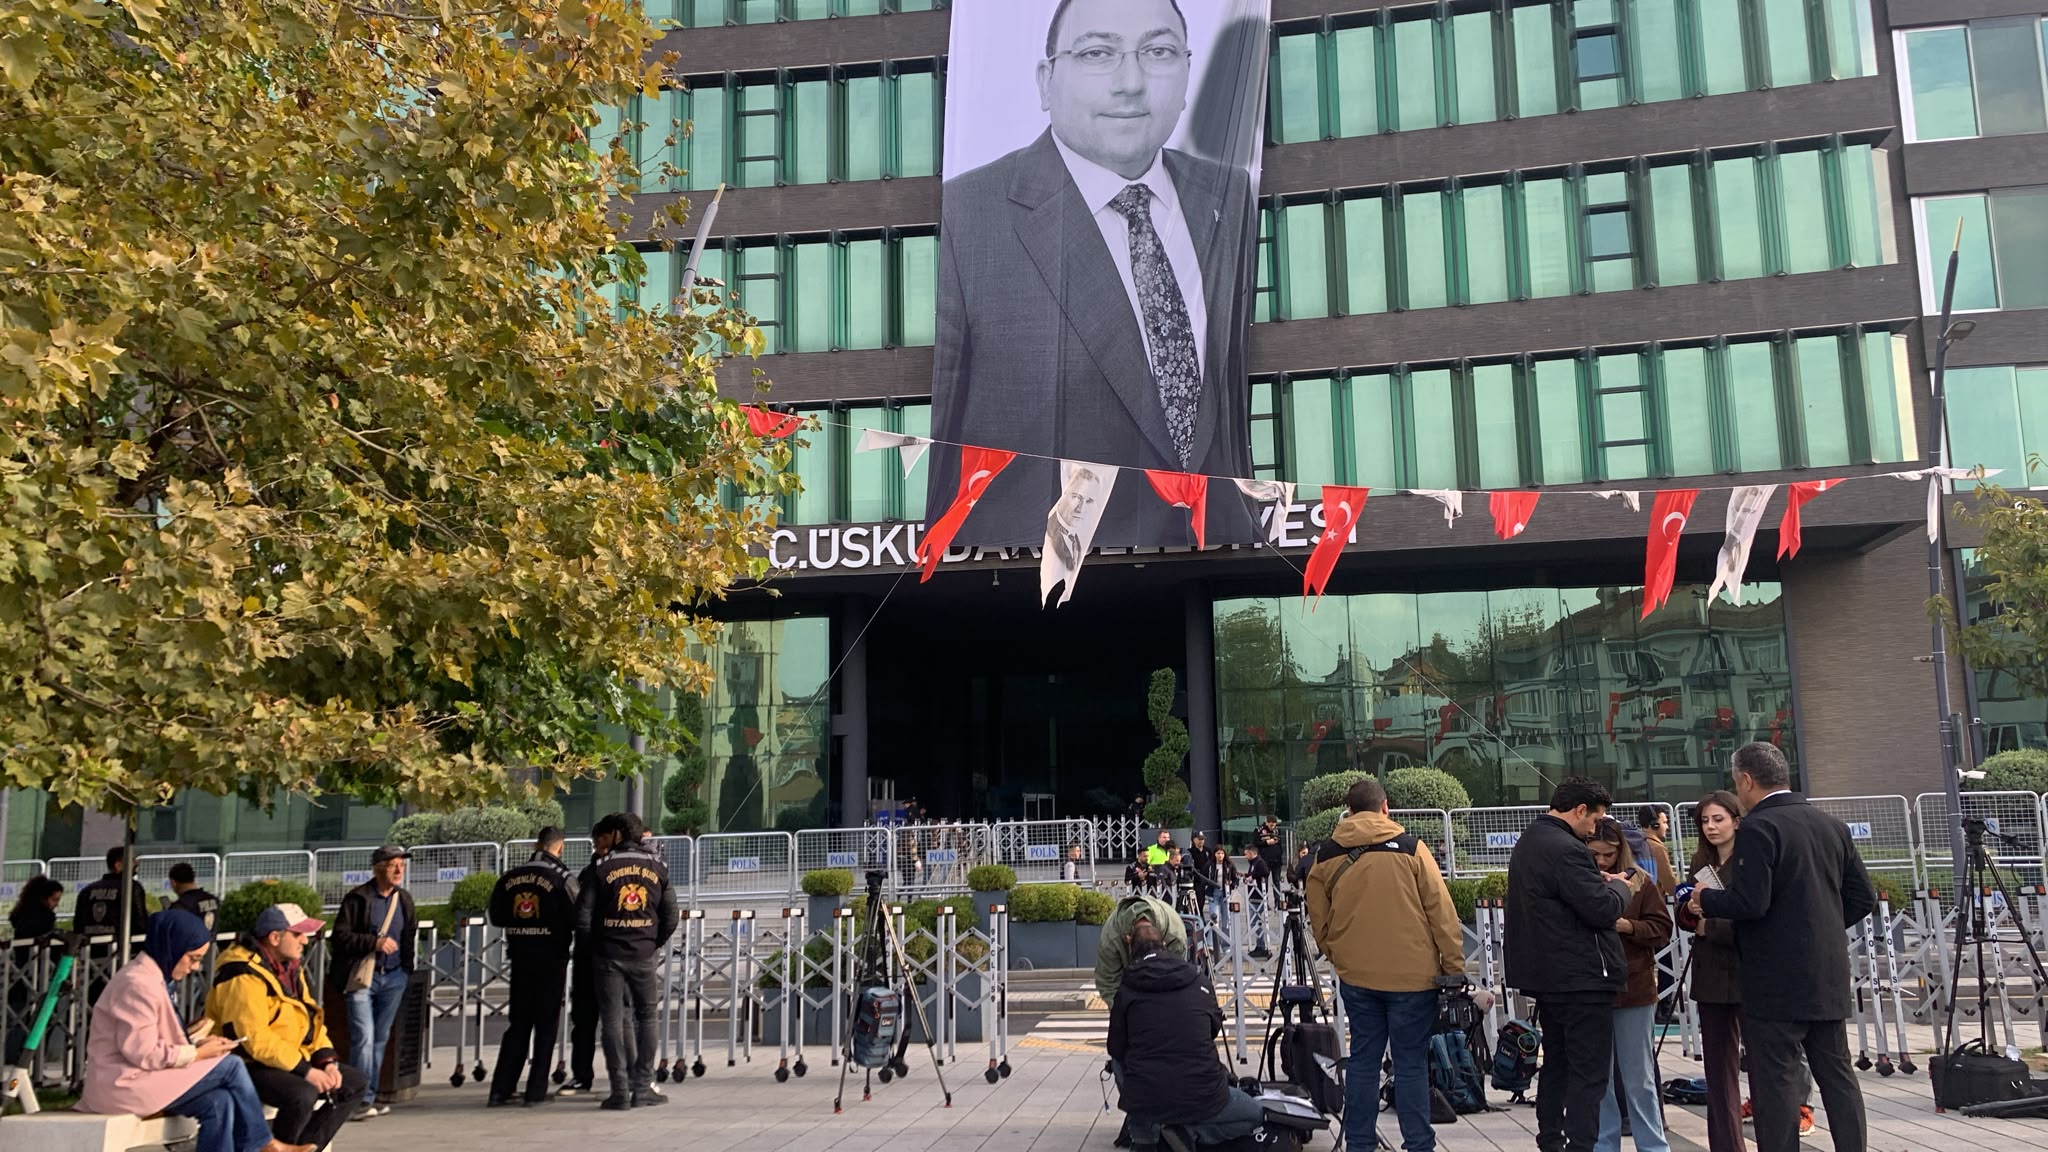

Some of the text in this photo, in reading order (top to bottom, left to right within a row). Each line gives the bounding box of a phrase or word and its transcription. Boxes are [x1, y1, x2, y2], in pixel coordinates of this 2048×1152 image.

[1851, 822, 1868, 836] LİS
[929, 850, 955, 862] POLİS
[1030, 846, 1057, 858] POLİS
[732, 858, 757, 870] POLİS
[830, 854, 856, 866] POLİS
